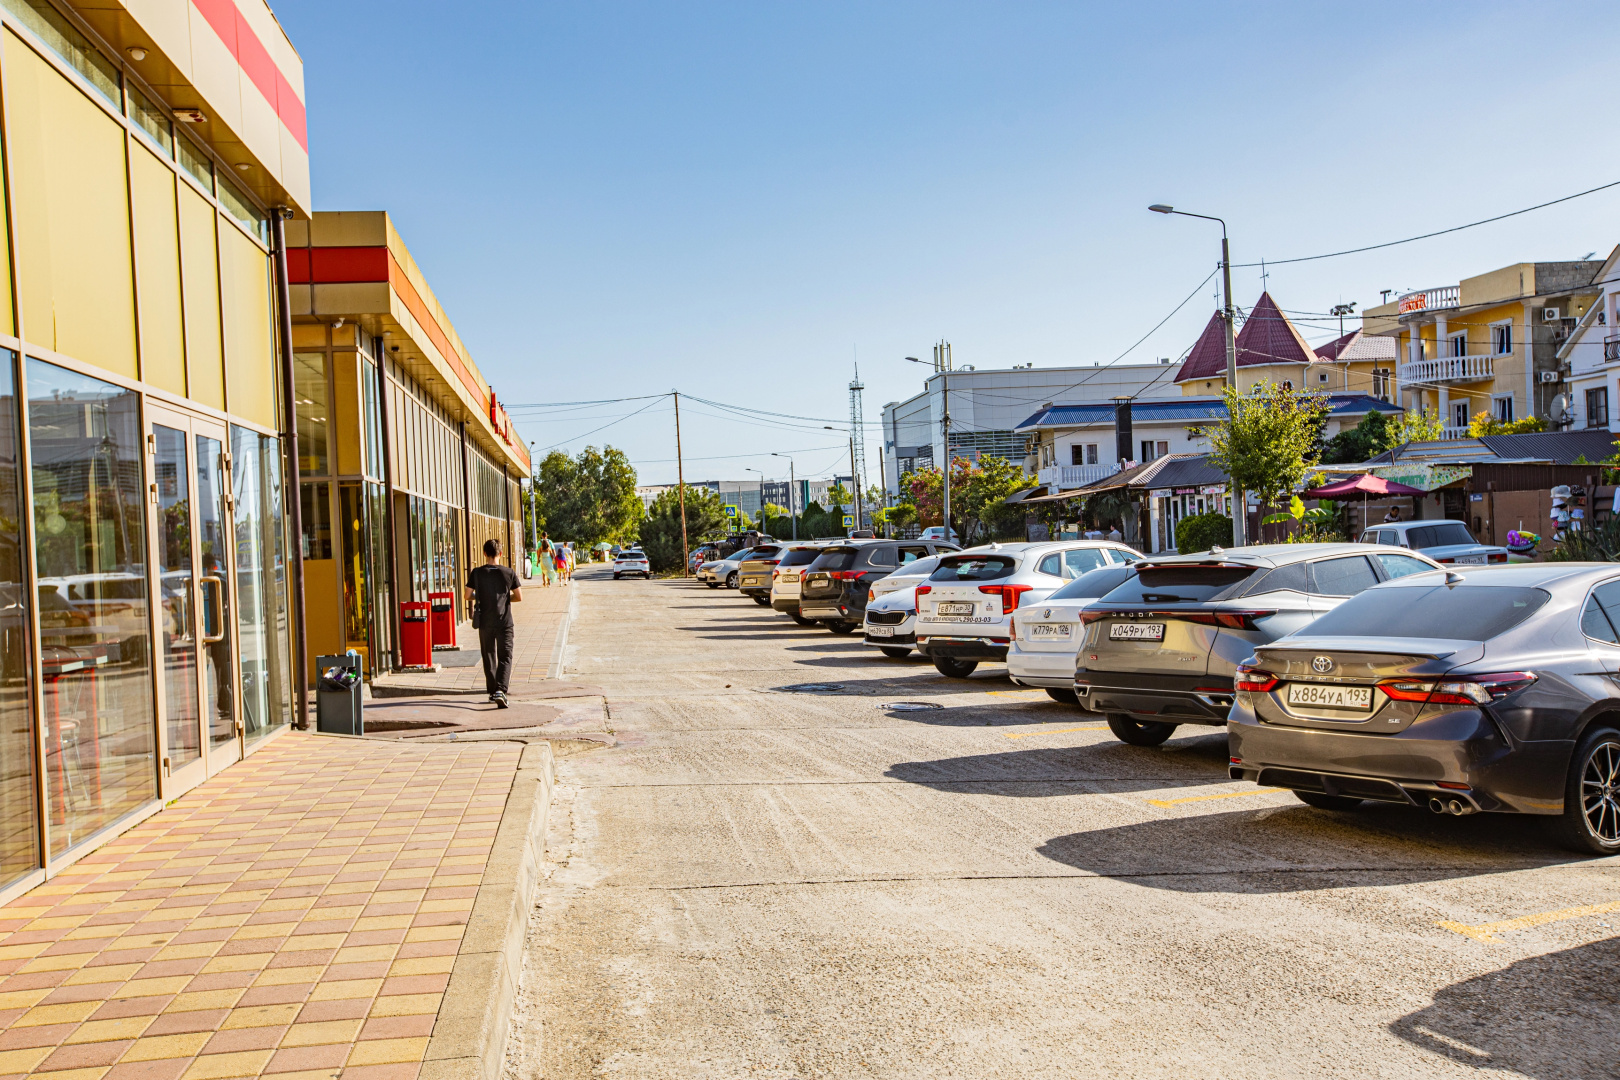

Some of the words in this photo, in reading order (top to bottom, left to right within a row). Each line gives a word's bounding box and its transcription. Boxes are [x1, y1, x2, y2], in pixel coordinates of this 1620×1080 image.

[1033, 625, 1058, 635] К779РА
[1059, 624, 1069, 632] 126
[1112, 625, 1146, 637] Х049РУ
[1147, 624, 1161, 635] 193
[1293, 686, 1344, 705] Х884УА
[1346, 688, 1369, 702] 193
